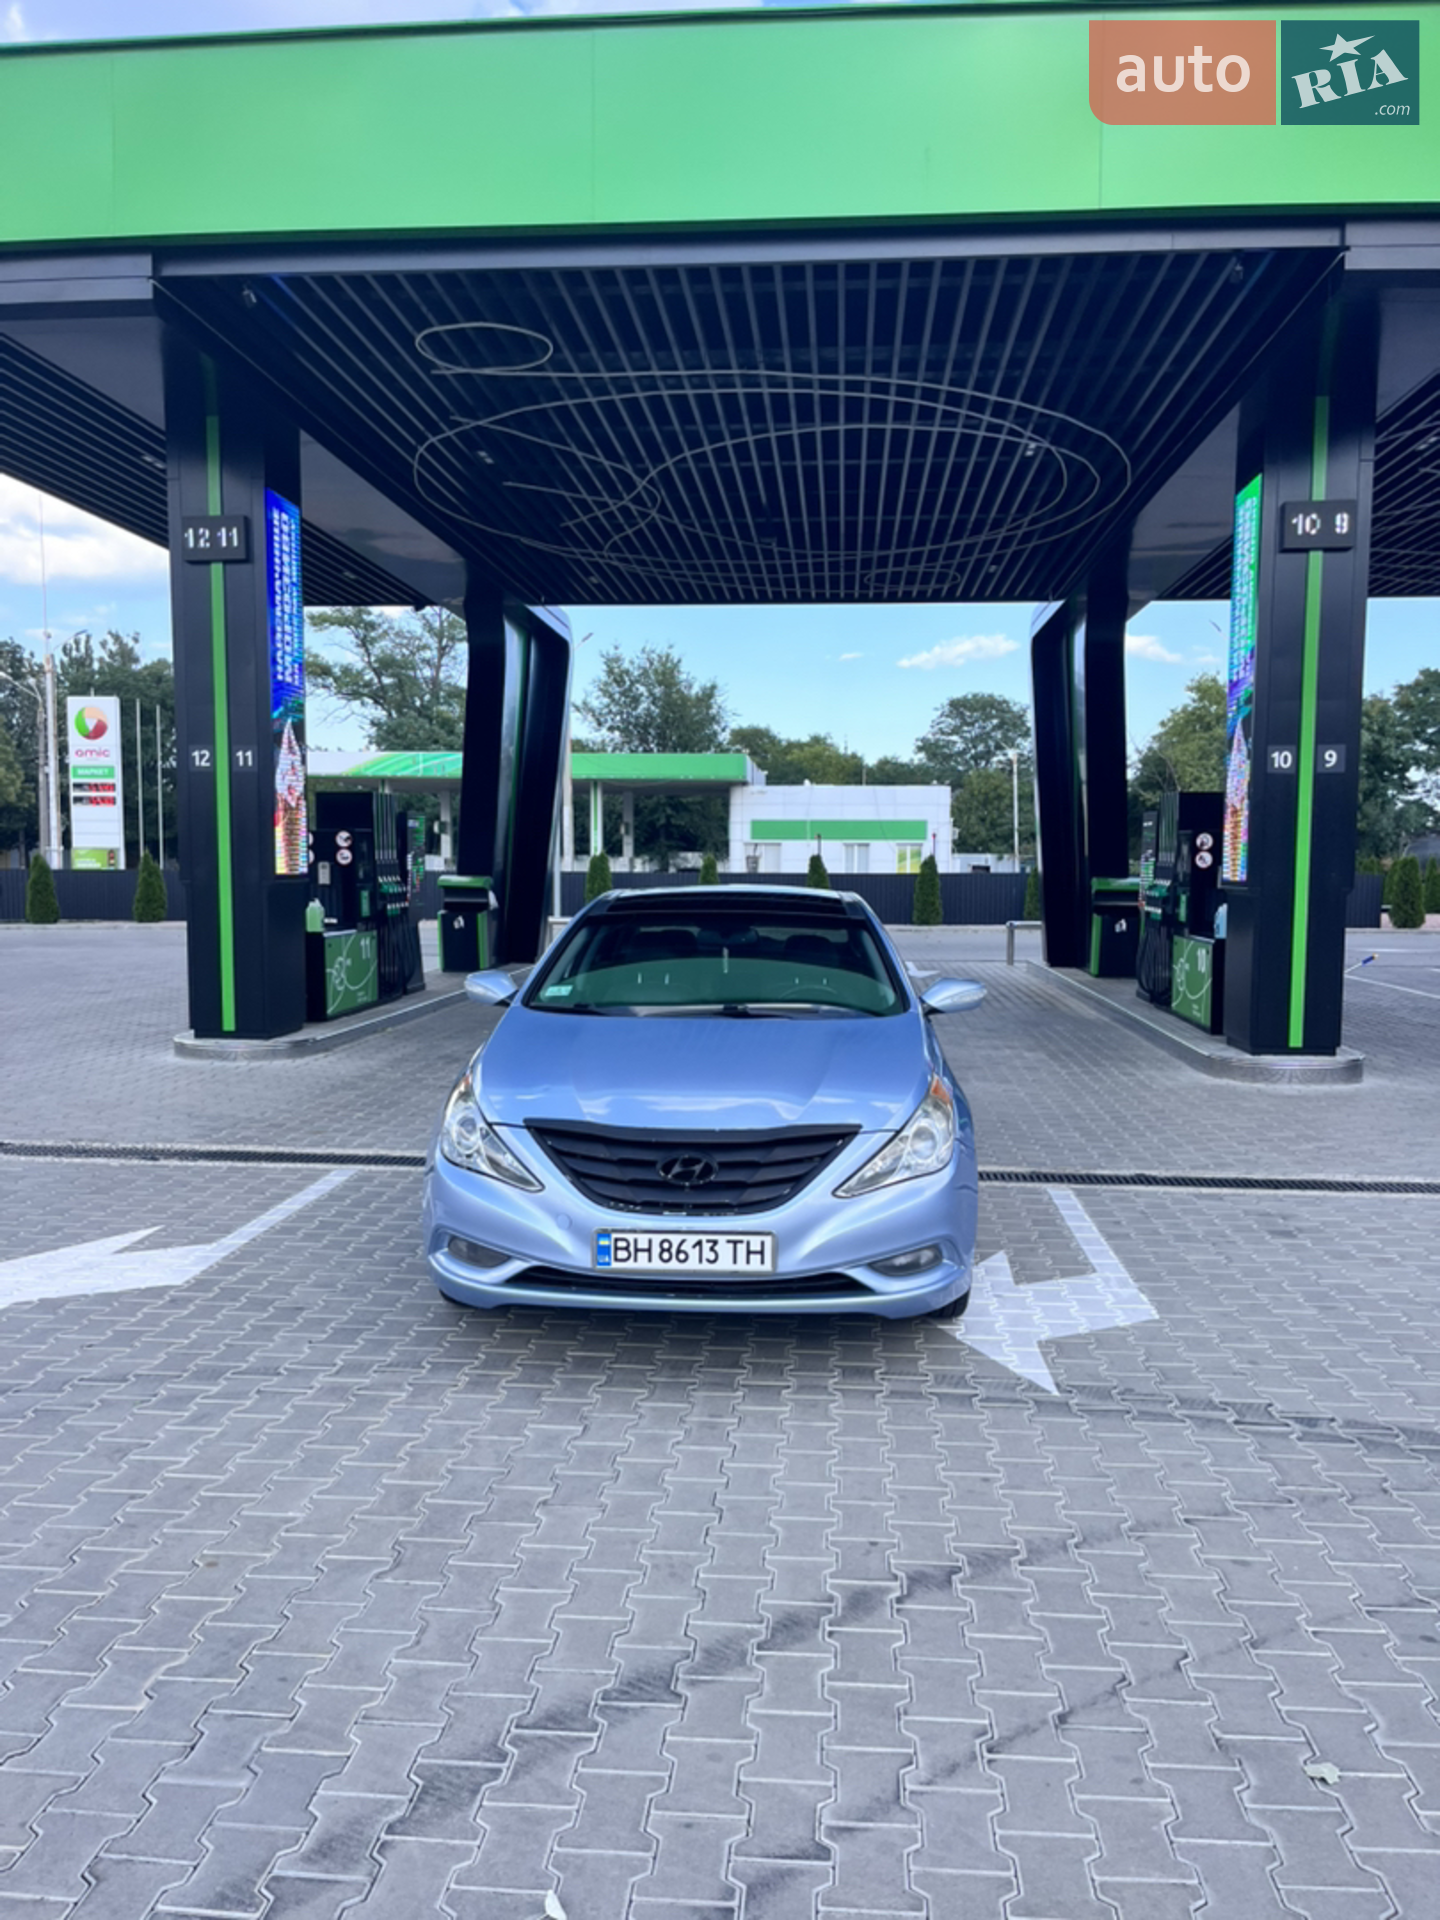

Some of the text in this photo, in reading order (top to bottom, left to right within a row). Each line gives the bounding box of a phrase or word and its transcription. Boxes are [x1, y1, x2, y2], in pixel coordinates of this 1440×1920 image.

[1292, 512, 1321, 536] 10
[184, 526, 239, 549] 12 11
[191, 749, 254, 767] 12 11
[1270, 749, 1338, 769] 10 9
[612, 1236, 766, 1266] BH 8613 TH
